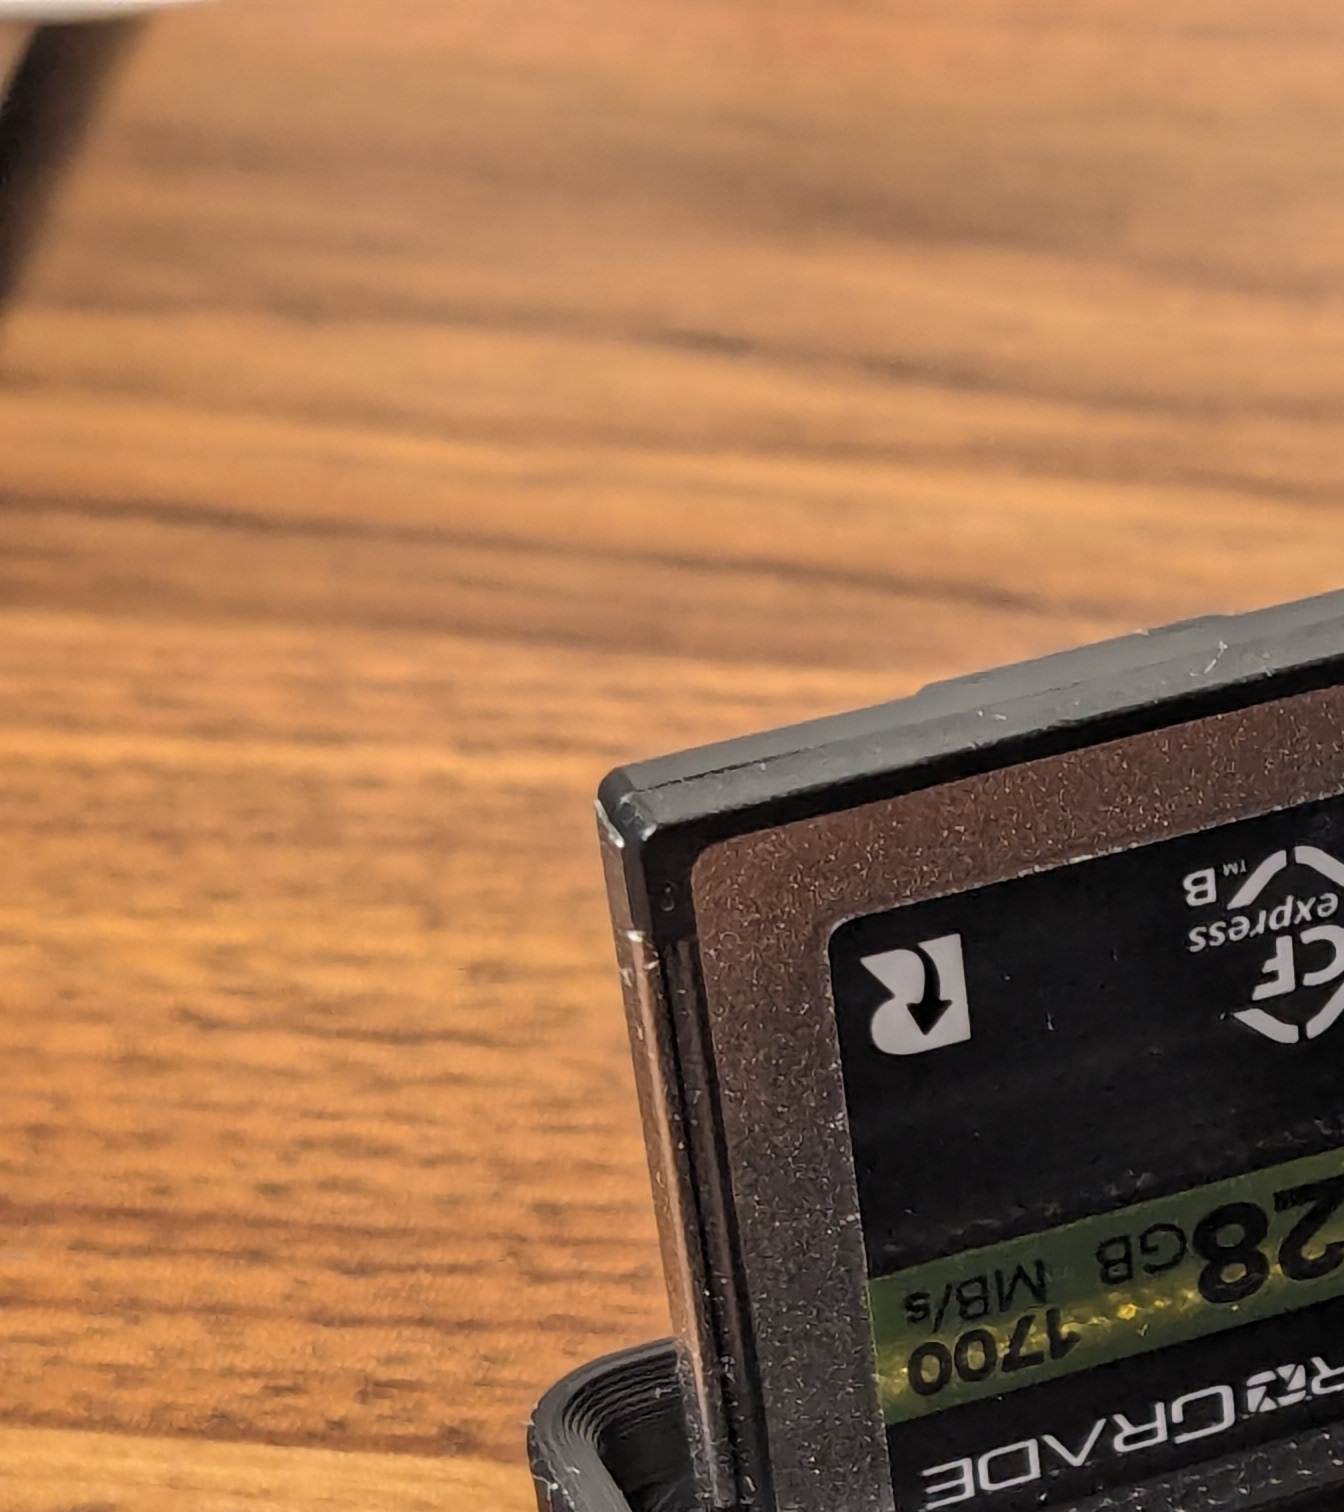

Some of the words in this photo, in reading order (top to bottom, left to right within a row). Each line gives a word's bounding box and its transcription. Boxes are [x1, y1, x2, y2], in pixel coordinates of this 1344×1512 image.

[1182, 869, 1217, 908] B
[1188, 891, 1339, 953] express
[906, 1258, 1047, 1330] MB/s
[907, 1304, 1081, 1397] 1700
